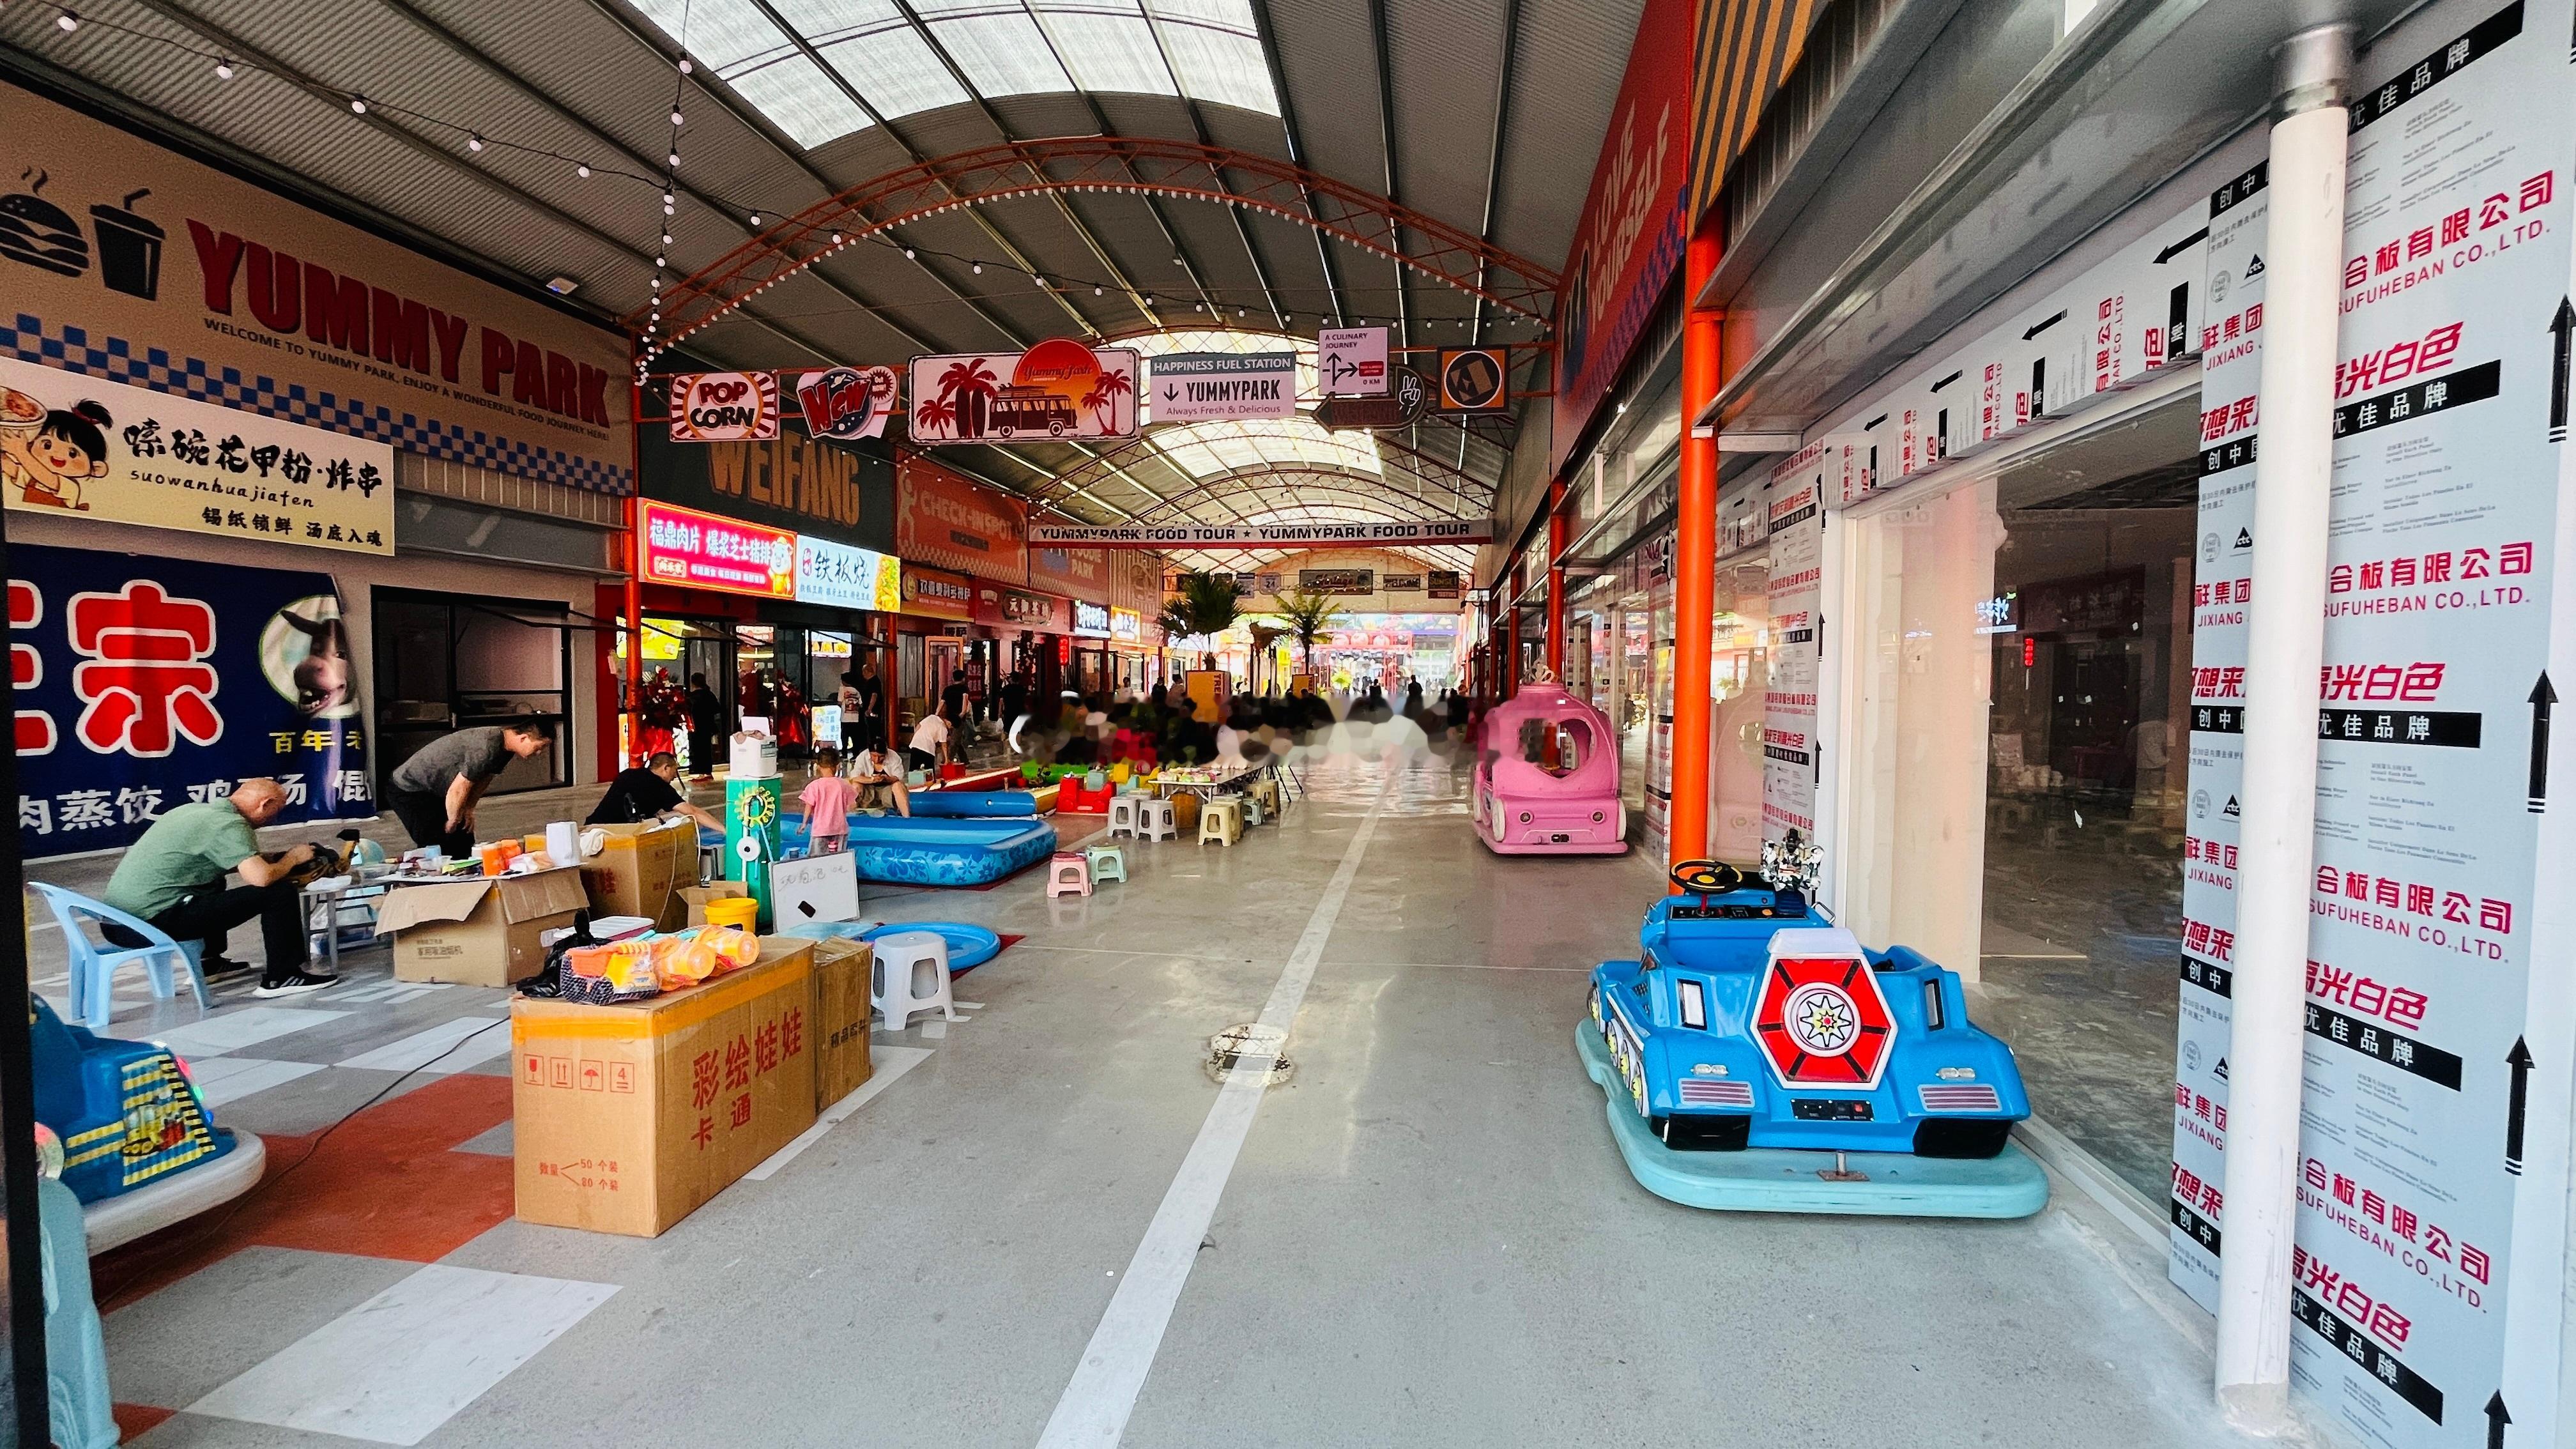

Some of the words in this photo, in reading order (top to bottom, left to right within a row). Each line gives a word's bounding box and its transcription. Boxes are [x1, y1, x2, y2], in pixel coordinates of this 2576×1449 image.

[1593, 98, 1636, 271] LOVE
[2220, 171, 2267, 209] 创中
[1592, 98, 1670, 336] YOURSELF
[2345, 171, 2554, 290] 合板有限公司
[185, 217, 468, 384] YUMMY
[481, 326, 610, 429] PARK
[1331, 332, 1368, 341] CULINARY
[2096, 297, 2112, 393] 有限公司
[2207, 340, 2254, 371] JIXIANG
[204, 318, 282, 349] WELCOME
[285, 341, 304, 356] TO
[309, 348, 361, 372] YUMMY
[402, 374, 440, 393] ENJOY
[441, 387, 451, 397] A
[453, 390, 516, 417] WONDERFUL
[518, 408, 544, 424] FOOD
[1154, 360, 1214, 372] HAPPINESS
[1216, 359, 1242, 370] FUEL
[1244, 358, 1291, 369] STATION
[697, 381, 749, 406] POP
[1186, 379, 1280, 402] YUMMYPARK
[690, 406, 756, 429] CORN
[1166, 406, 1198, 417] Always
[1200, 406, 1225, 415] Fresh
[1227, 406, 1236, 414] &
[1239, 405, 1281, 414] Delicious
[2200, 395, 2258, 442] 想来
[709, 430, 862, 528] WEIFANG
[305, 521, 383, 548] 汤底入魂
[649, 518, 700, 555] 福鼎肉片
[1041, 527, 1142, 540] YUMMYPARK
[1146, 528, 1188, 540] FOOD
[1193, 527, 1236, 540] TOUR
[1259, 525, 1366, 540] YUMMYPARK
[1373, 524, 1419, 538] FOOD
[1423, 523, 1471, 537] TOUR
[815, 548, 870, 590] 铁板烧
[1071, 559, 1094, 580] PARK
[2330, 542, 2533, 594] 合板有限公司
[2198, 611, 2243, 627] JIXIANG
[2191, 666, 2246, 698] 想来
[2198, 708, 2244, 730] 创中
[19, 783, 163, 836] 肉蒸饺
[187, 772, 307, 806] 鸡汤
[2188, 868, 2232, 891] JIXIANG
[2310, 898, 2410, 937] SUFUHEBAN
[2317, 865, 2512, 935] 合板有限公司
[2189, 960, 2221, 990] 创中
[691, 1006, 803, 1111] 彩绘娃娃
[690, 1091, 752, 1151] 卡通
[2179, 1115, 2223, 1151] JIXIANG
[539, 1162, 560, 1177] 数量
[2179, 1208, 2211, 1245] 创中
[2297, 1185, 2395, 1257] SUFUHEBAN
[2305, 1156, 2491, 1285] 合板有限公司
